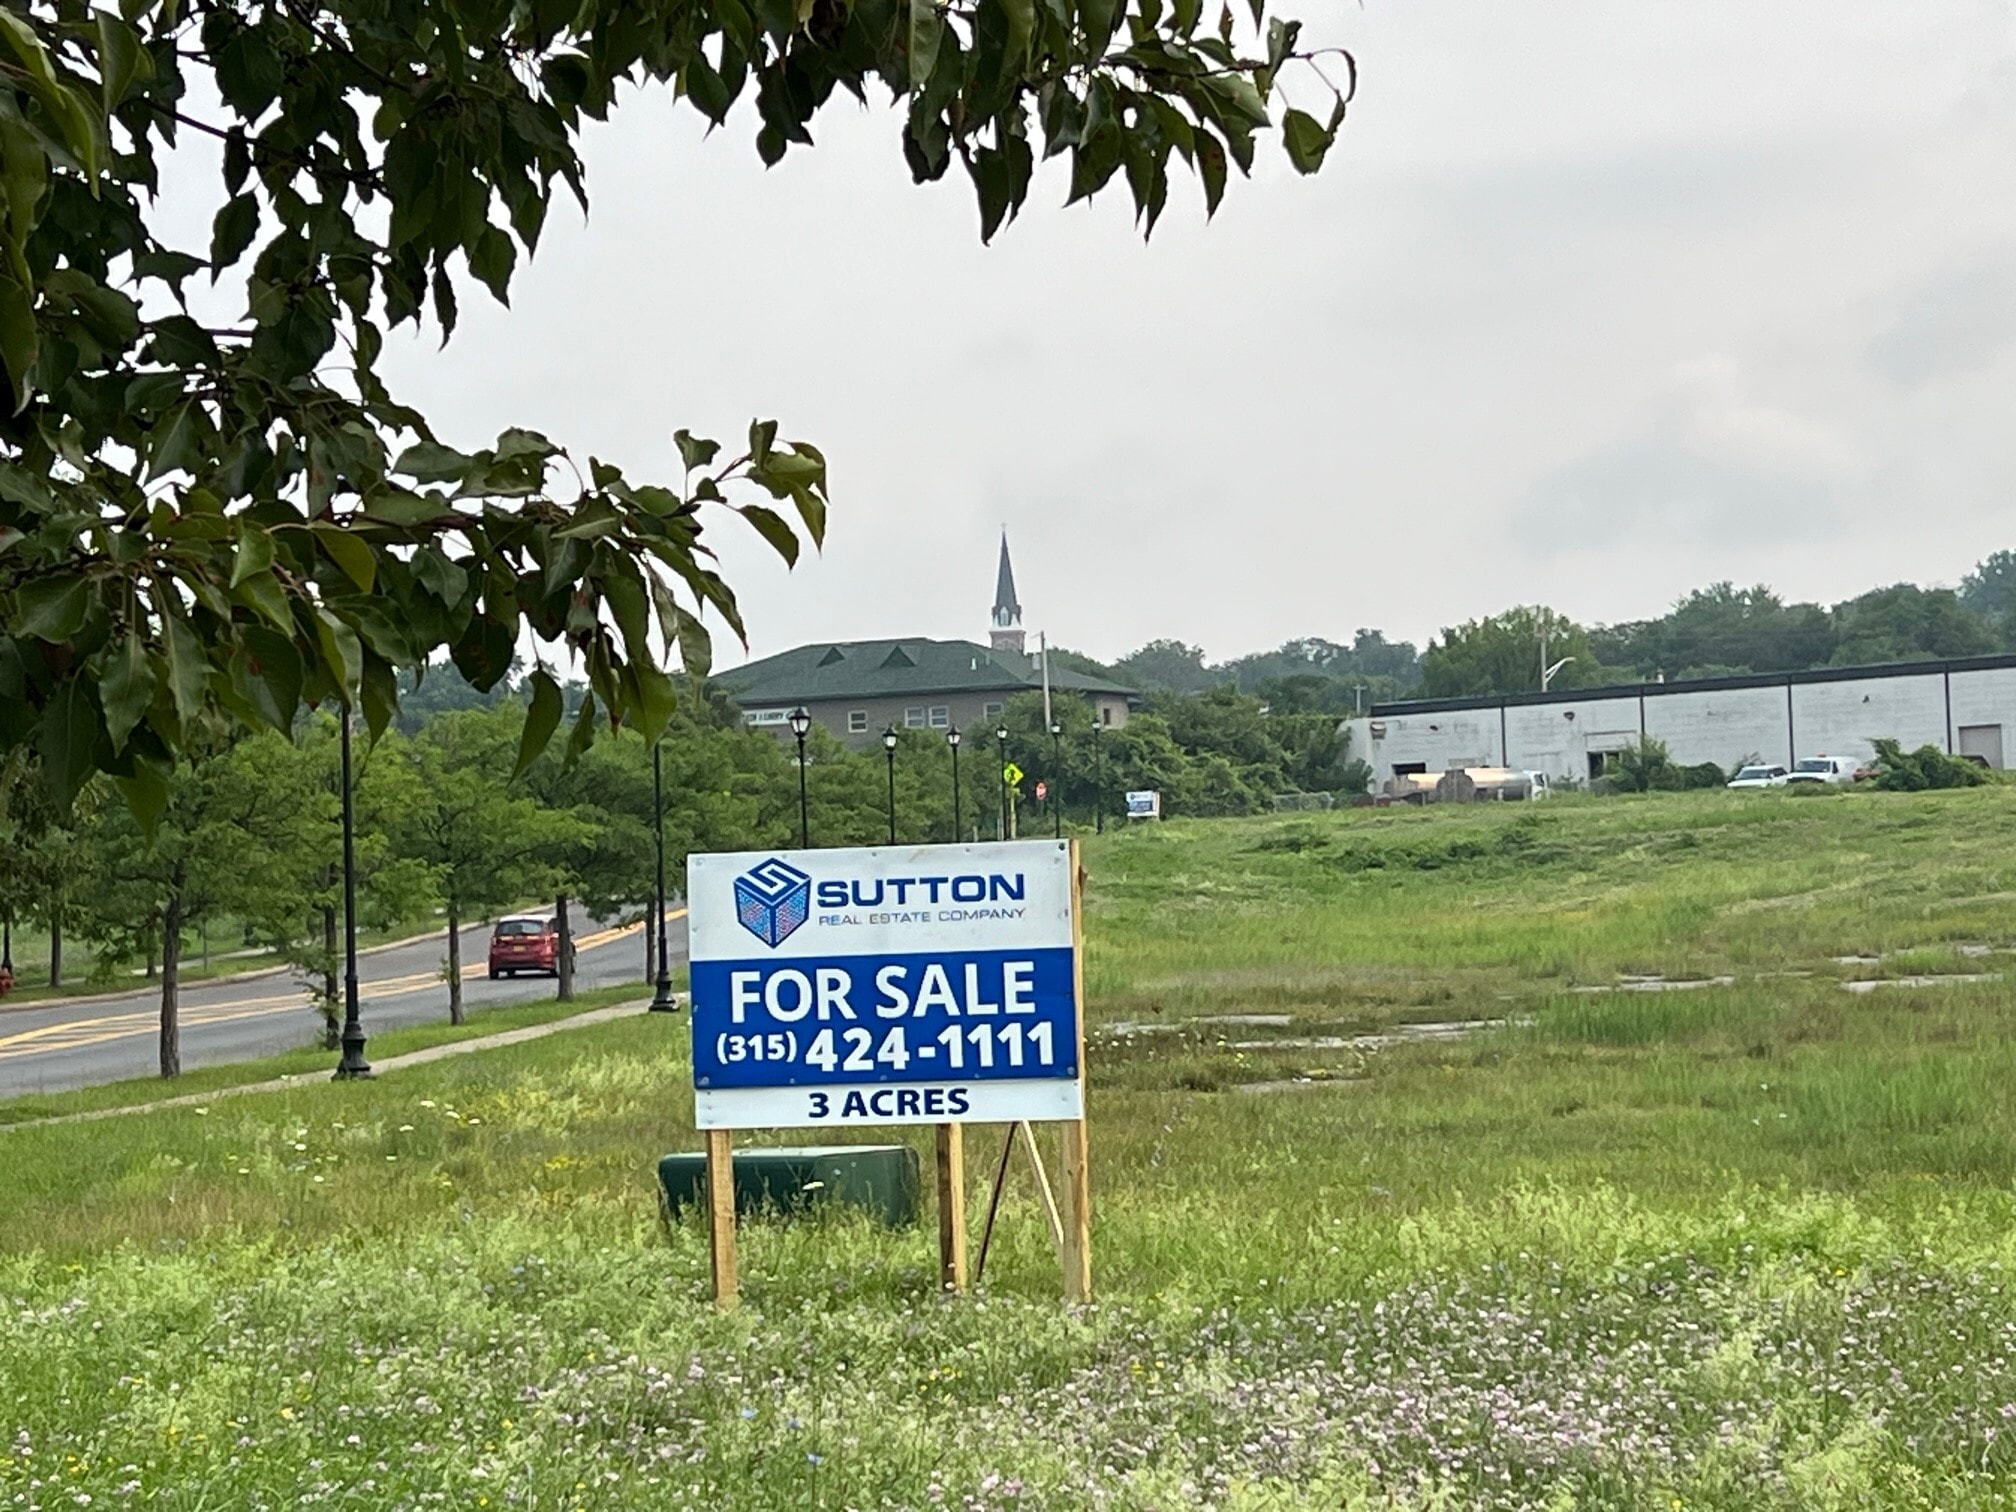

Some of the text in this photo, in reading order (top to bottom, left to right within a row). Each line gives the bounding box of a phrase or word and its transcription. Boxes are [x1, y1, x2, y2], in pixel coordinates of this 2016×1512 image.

[817, 873, 1025, 908] SUTTON
[819, 907, 1026, 926] REAL ESTATE COMPANY
[731, 960, 1036, 1024] FOR SALE
[716, 1021, 1054, 1072] (315) 424-1111
[808, 1088, 970, 1119] 3 ACRES
